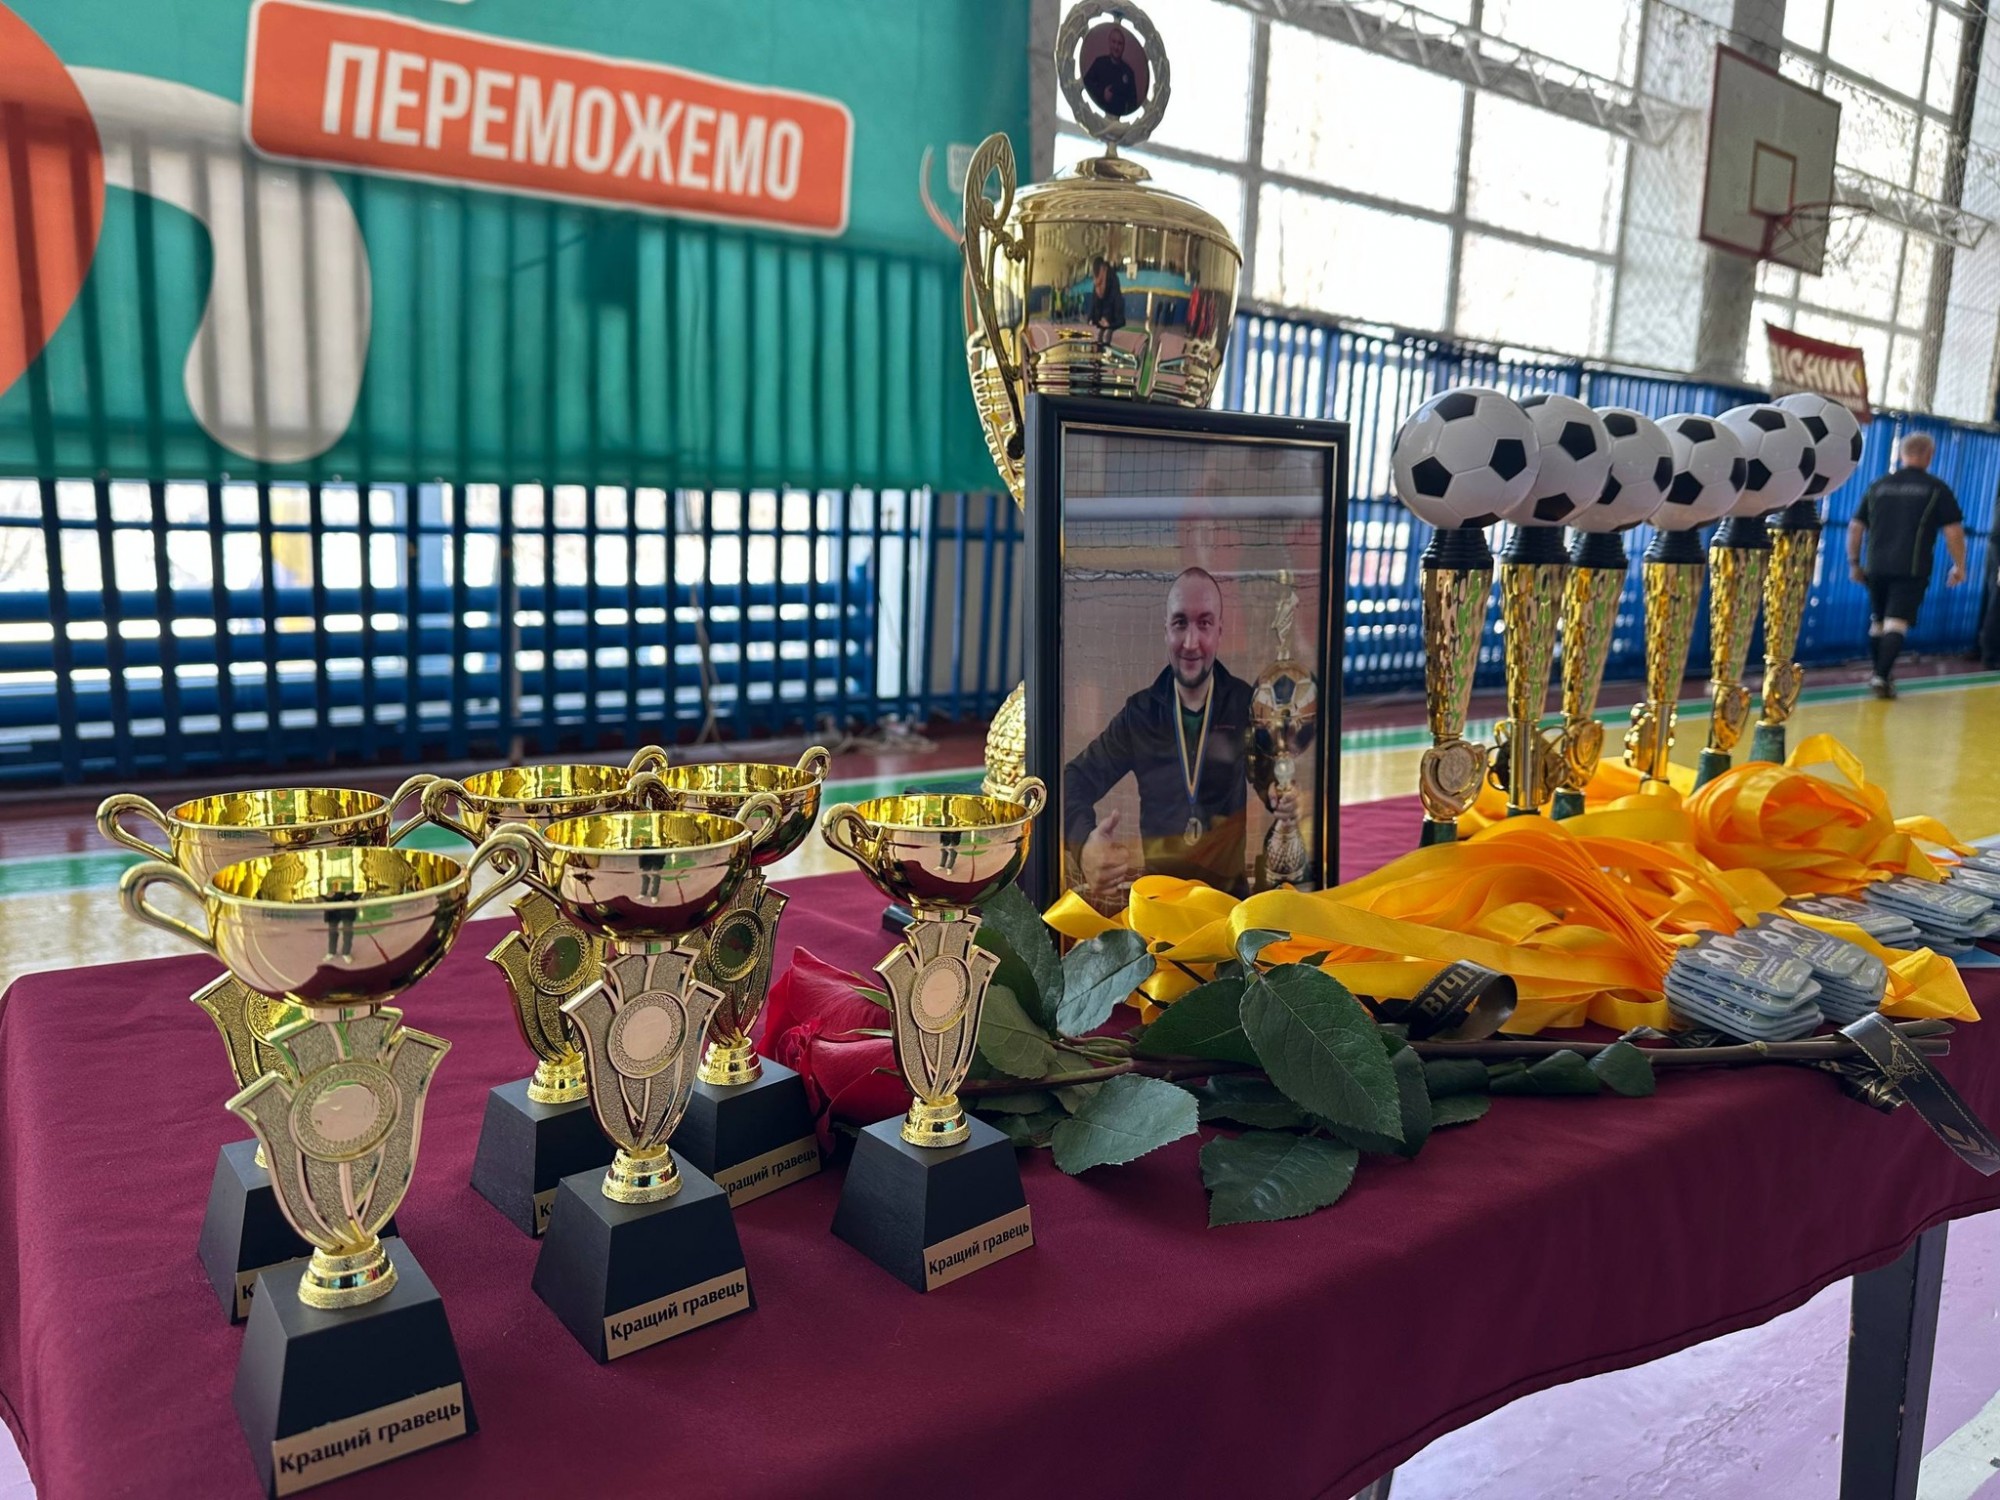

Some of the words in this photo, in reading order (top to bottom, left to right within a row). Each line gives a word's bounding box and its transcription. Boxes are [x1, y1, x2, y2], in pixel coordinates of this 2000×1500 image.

[321, 40, 804, 201] ПЕРЕМОЖЕМО
[772, 1149, 818, 1177] гравець
[929, 1240, 980, 1275] Кращий
[983, 1222, 1030, 1253] гравець
[610, 1302, 678, 1341] Кращий
[683, 1281, 745, 1316] гравець
[279, 1427, 372, 1474] Кращий
[378, 1403, 462, 1442] гравець
